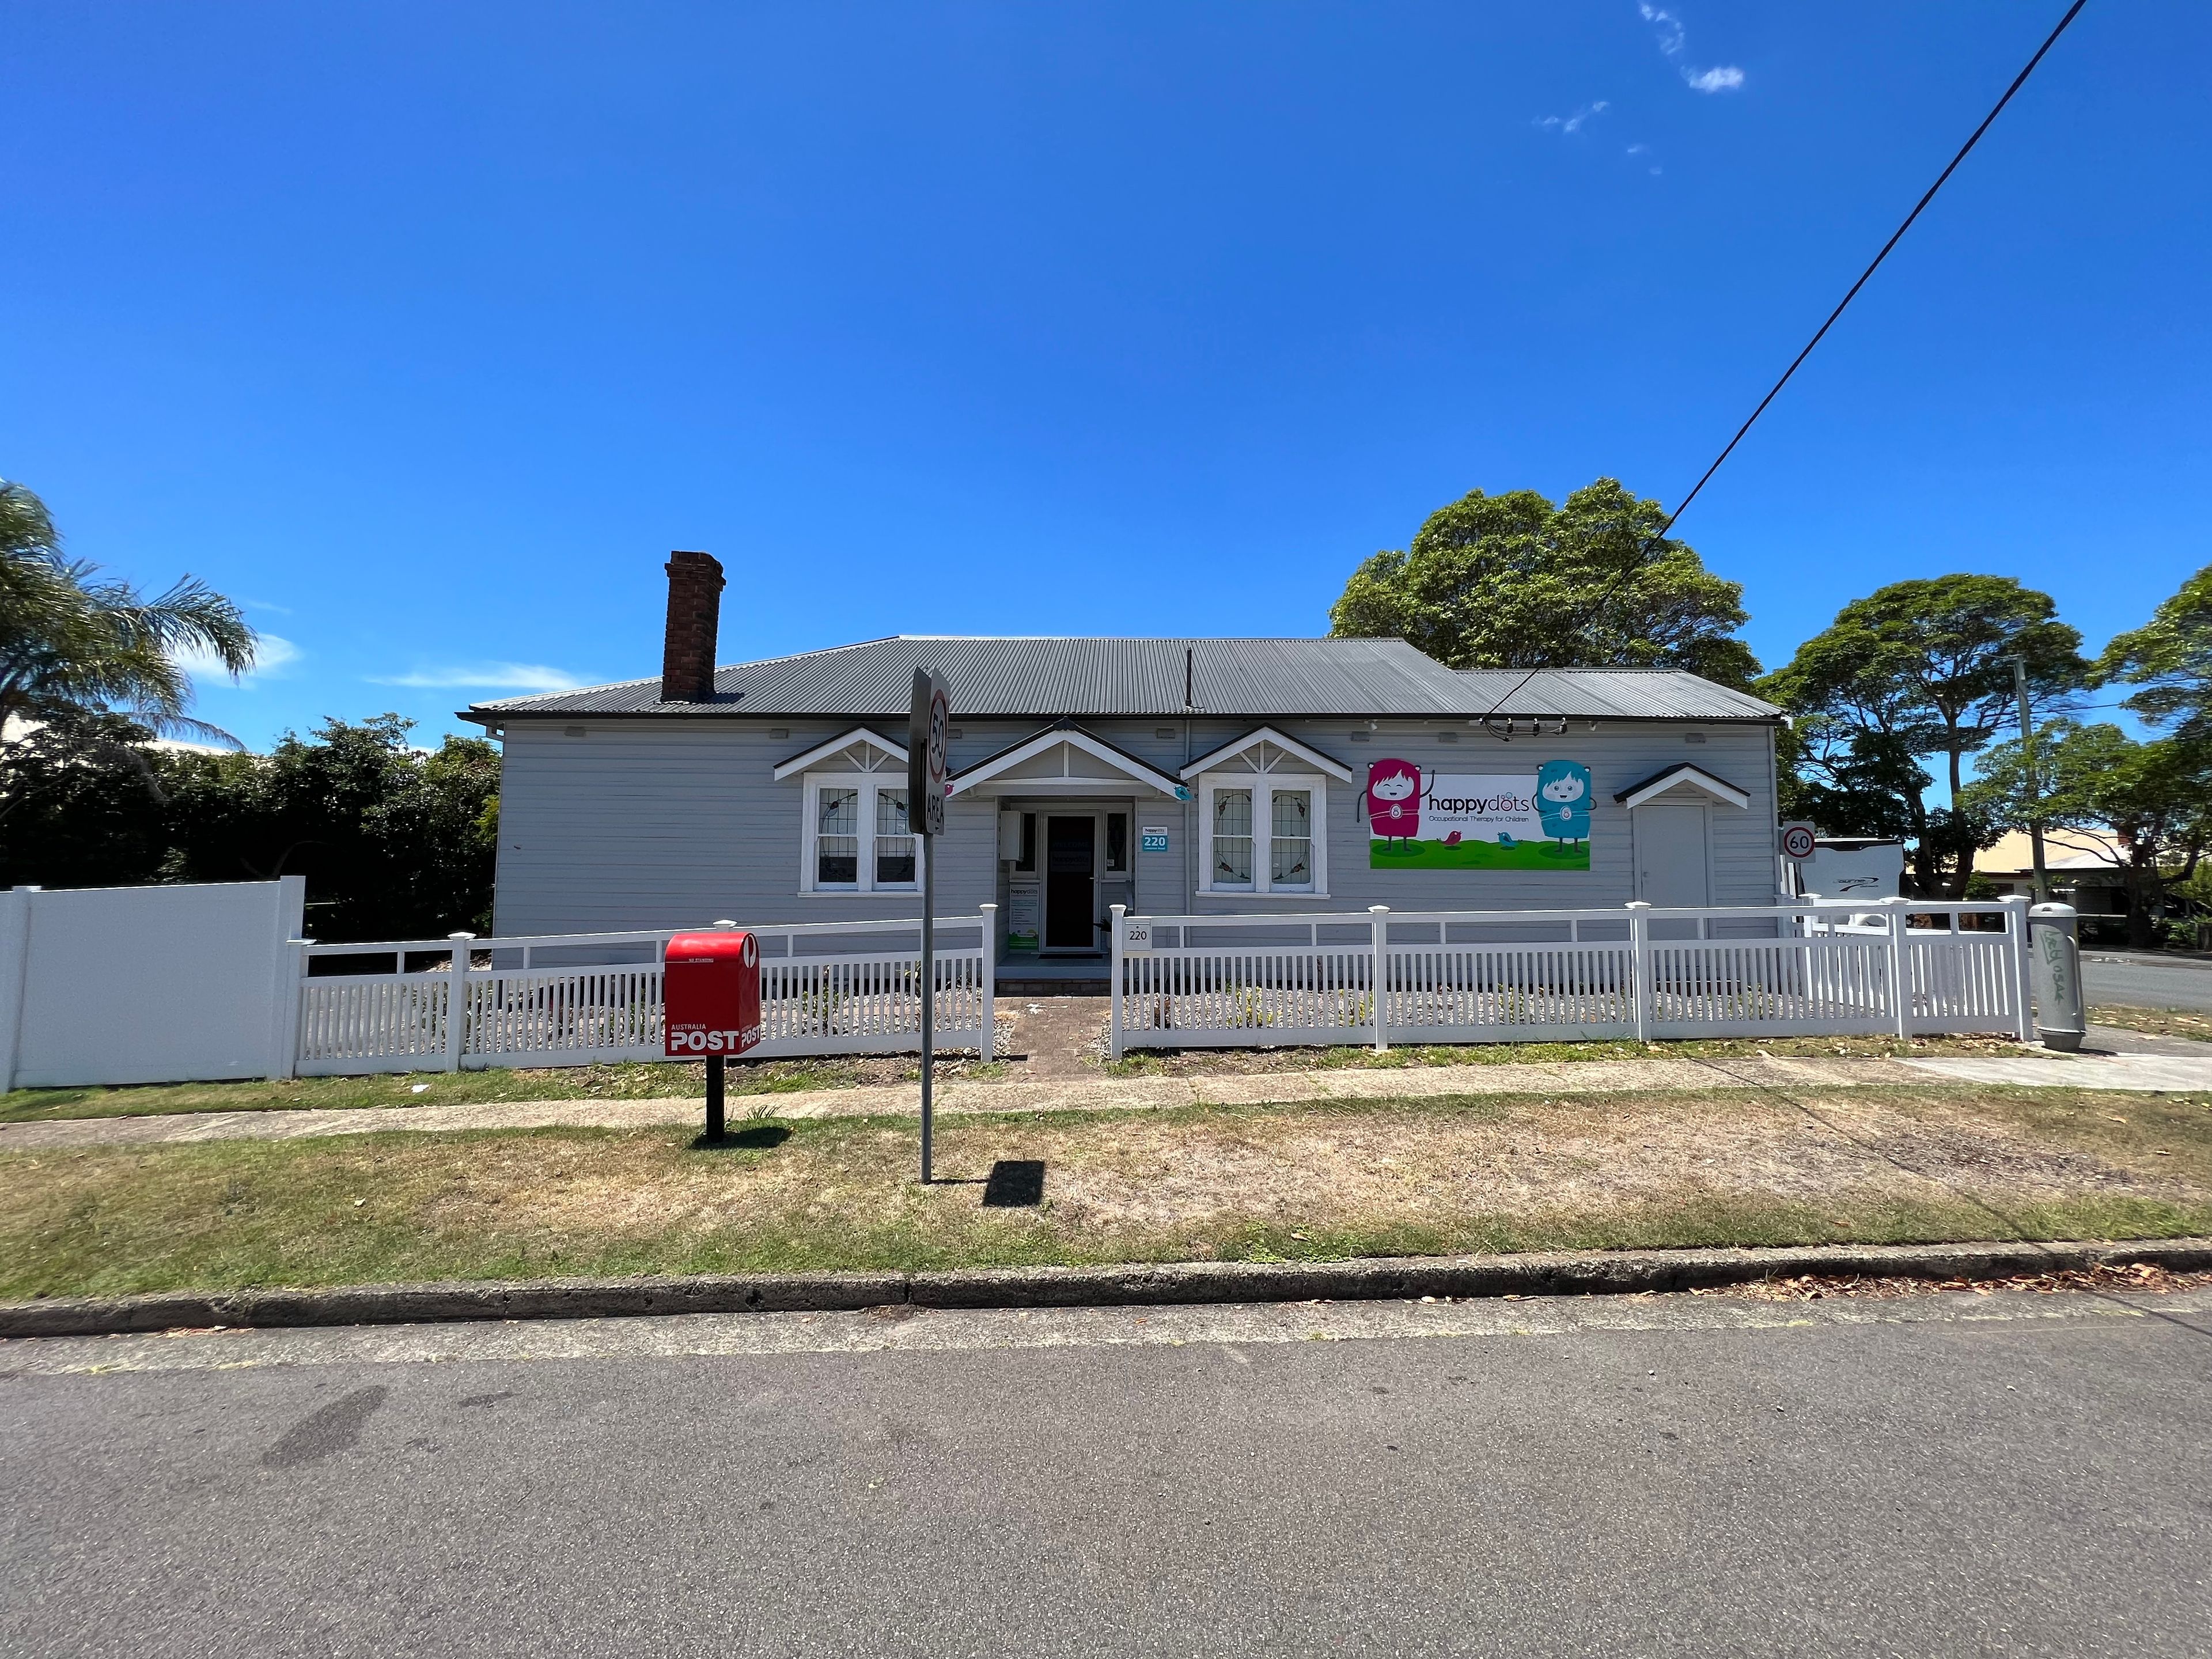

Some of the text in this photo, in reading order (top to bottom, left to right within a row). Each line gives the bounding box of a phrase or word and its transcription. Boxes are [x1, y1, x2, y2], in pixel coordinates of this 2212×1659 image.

[931, 713, 944, 759] 50
[927, 793, 944, 824] AREA
[1429, 793, 1529, 814] happydots
[1144, 837, 1165, 846] 220
[1790, 835, 1809, 849] 60
[1129, 931, 1147, 940] 220
[671, 1031, 739, 1051] POST
[741, 1025, 760, 1048] POST
